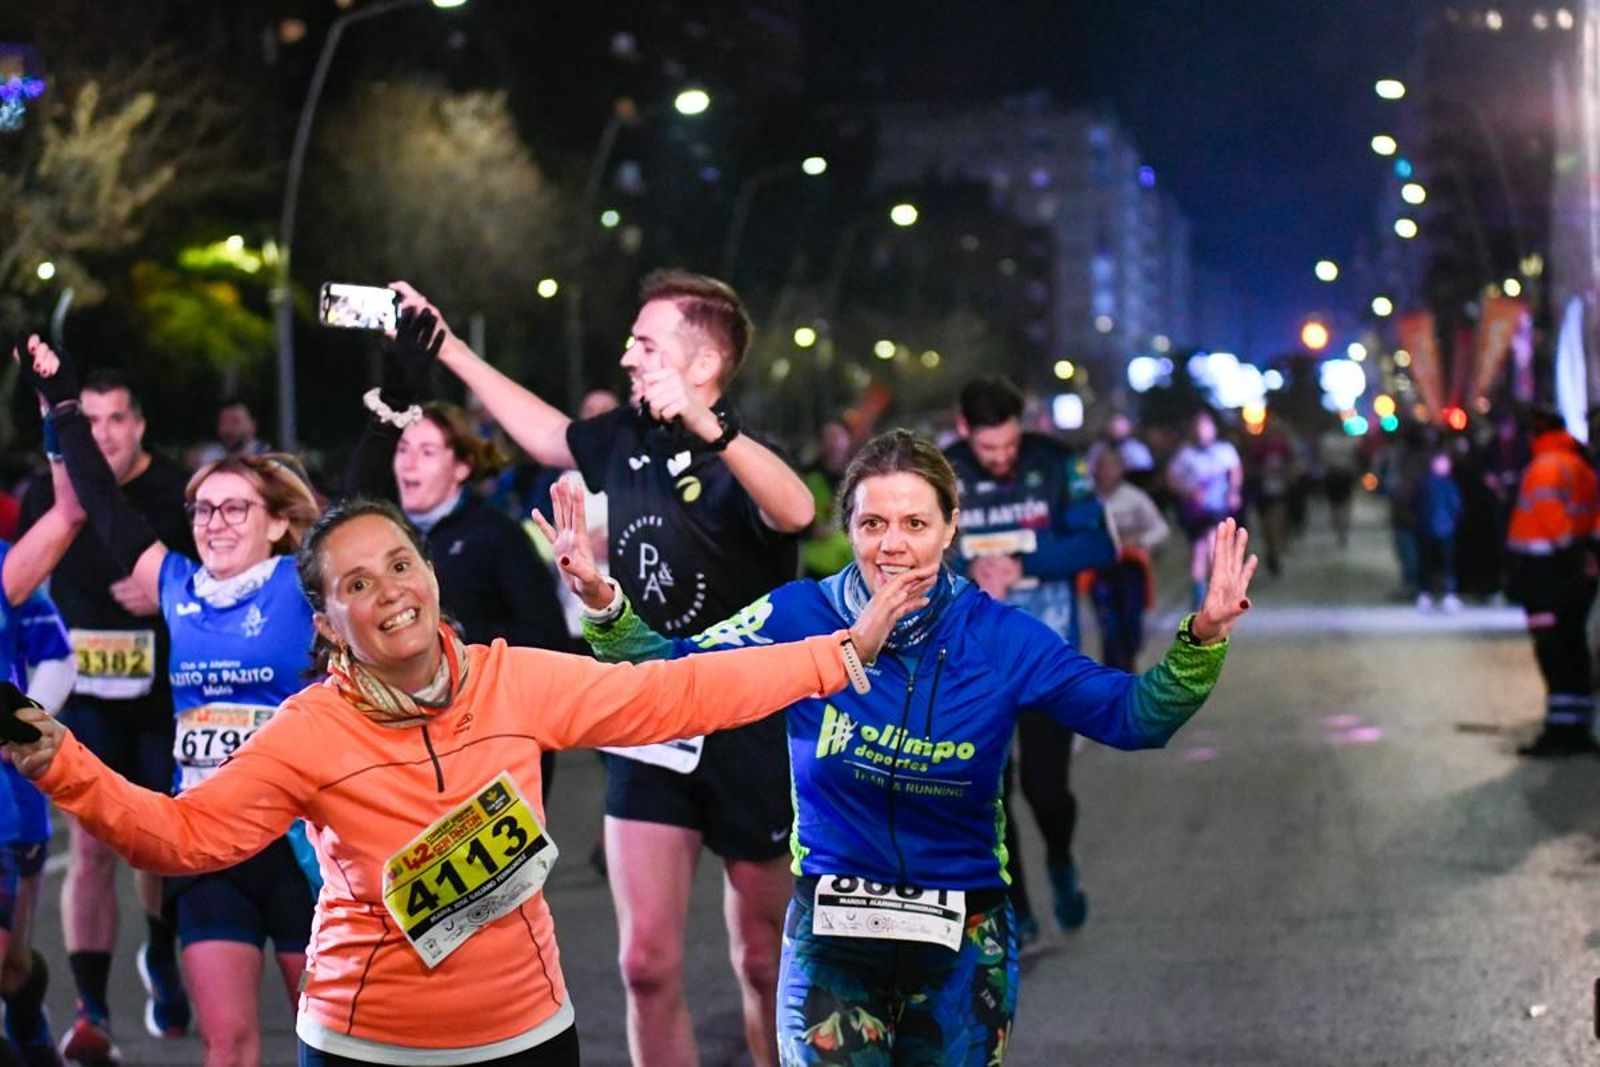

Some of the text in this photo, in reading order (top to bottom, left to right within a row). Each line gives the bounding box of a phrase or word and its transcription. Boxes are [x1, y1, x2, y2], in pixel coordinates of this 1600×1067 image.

[182, 729, 256, 759] 679
[854, 744, 928, 772] deportes
[860, 724, 975, 764] olimpo
[905, 783, 964, 798] RUNNING
[406, 816, 528, 917] 4113
